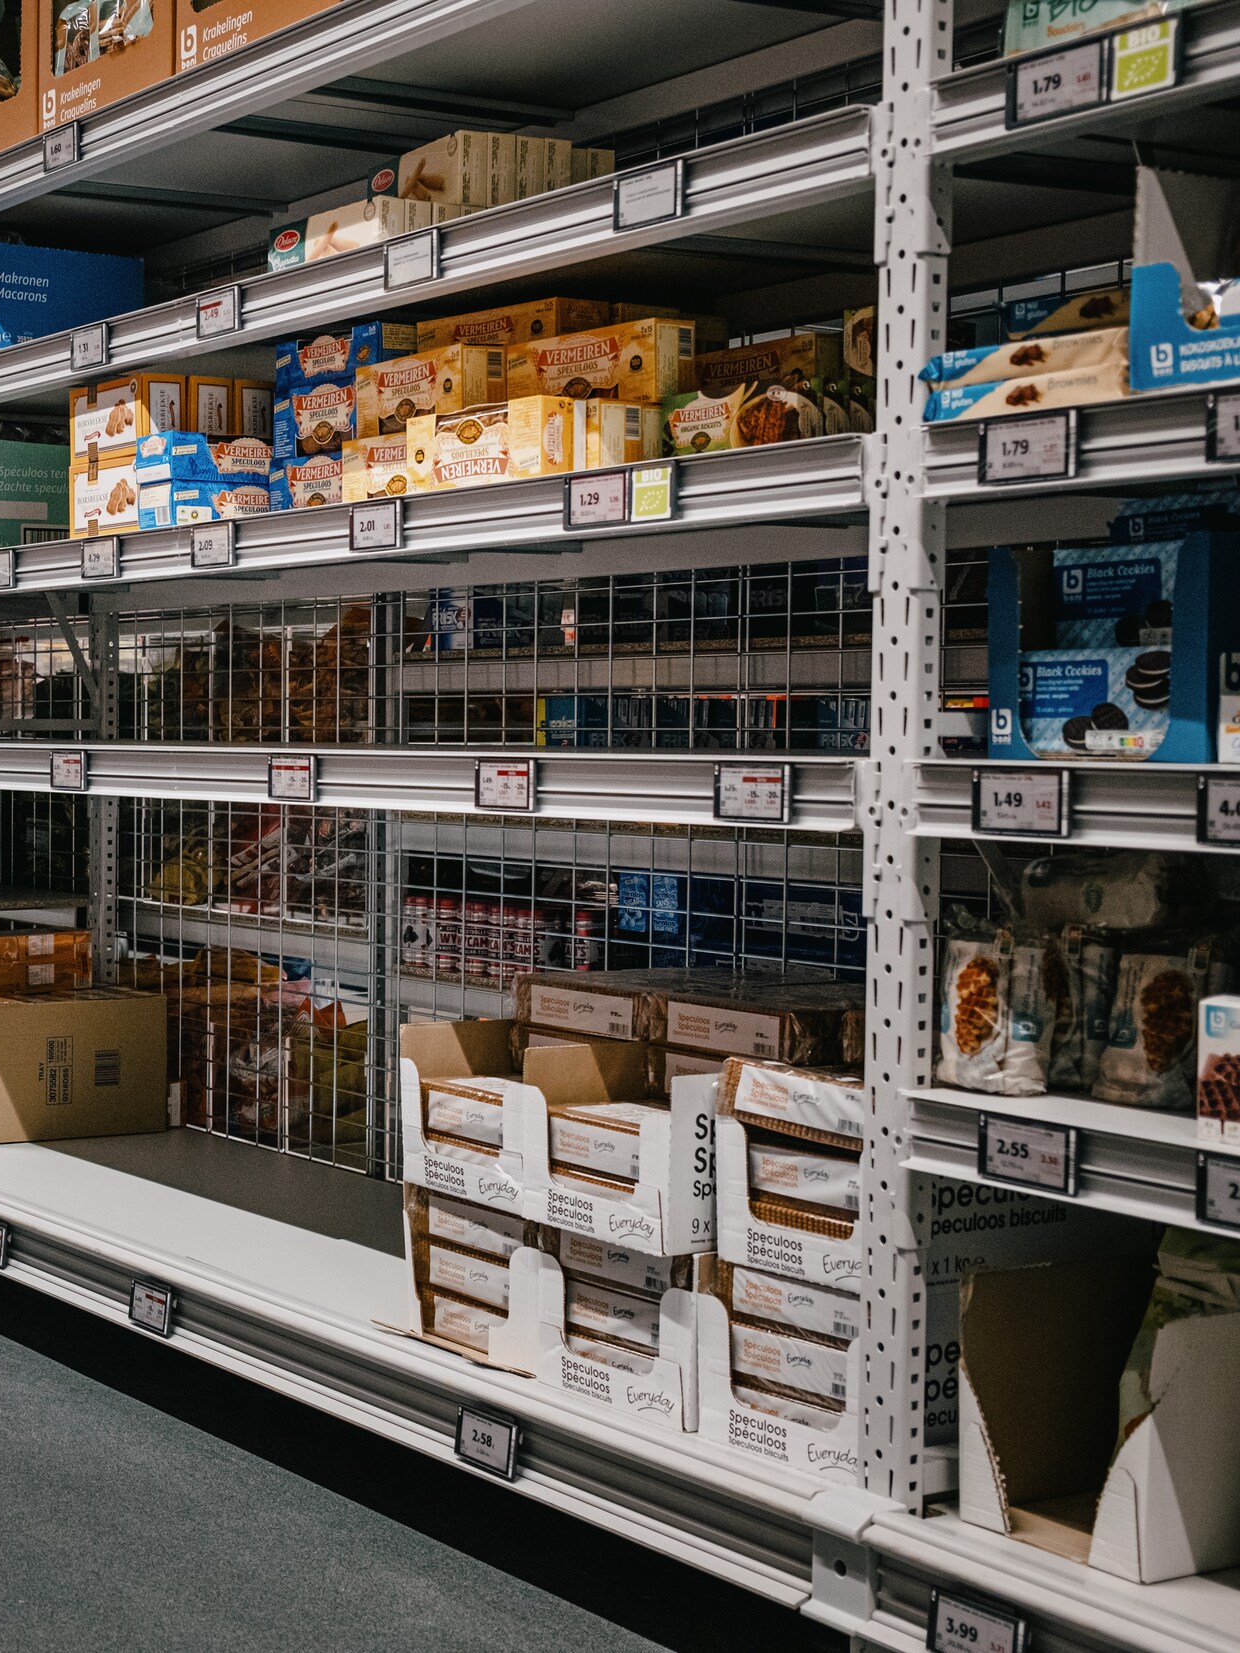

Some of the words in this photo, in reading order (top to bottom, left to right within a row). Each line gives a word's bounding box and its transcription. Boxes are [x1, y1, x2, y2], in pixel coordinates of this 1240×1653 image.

[202, 10, 253, 42] Krakelingen
[1128, 26, 1160, 48] BIO
[202, 32, 248, 61] Craquelins
[181, 58, 197, 70] boni
[60, 78, 102, 105] Krakelingen
[1032, 74, 1062, 95] 1,79
[60, 98, 98, 122] Craquelins
[43, 118, 56, 129] boni
[459, 318, 507, 337] VERMEIREN
[306, 343, 342, 358] VERMEIREN
[1052, 334, 1104, 350] Brownies
[1178, 336, 1240, 356] KOKOSKOEK
[546, 339, 610, 365] VERMEIREN
[312, 356, 336, 366] SPECULOOS
[556, 360, 598, 376] SPECULOOS
[710, 354, 773, 378] VERMEIREN
[1180, 354, 1221, 373] BISCUITS
[384, 366, 430, 387] VERMEIREN
[1047, 374, 1098, 391] Brownies
[392, 384, 421, 397] SPECULOOS
[302, 390, 348, 410] VERMEIREN
[310, 406, 339, 419] SPECULOOS
[680, 405, 726, 422] VERMEIREN
[77, 416, 108, 429] BORSBEEKSE
[224, 444, 274, 458] VERMEIREN
[374, 447, 407, 462] VERMEI
[1002, 439, 1029, 456] 1,79
[231, 458, 266, 466] SPECULOOS
[441, 458, 500, 480] VERMEIREN
[295, 462, 342, 481] VERMEIREN
[641, 466, 662, 482] BIO
[303, 479, 332, 490] SPECULOOS
[77, 492, 108, 505] BORSBEEKSE
[226, 492, 270, 505] VERMEIRE
[580, 492, 600, 506] 1,29
[360, 520, 375, 532] 2,01
[1087, 567, 1115, 578] Black
[1118, 564, 1155, 576] Cookies
[1036, 666, 1062, 677] Black
[1064, 665, 1102, 676] Cookies
[992, 792, 1024, 808] 1,49
[622, 890, 644, 898] mentos
[573, 1002, 595, 1012] Everyday
[678, 1012, 710, 1026] Speculoos
[714, 1020, 738, 1031] Everyday
[466, 1110, 484, 1121] Everyday
[594, 1140, 616, 1151] Everyday
[996, 1140, 1030, 1159] 2,55
[424, 1155, 465, 1176] Speculoos
[762, 1156, 798, 1172] Speculoos
[424, 1166, 466, 1188] Spéculoos
[804, 1168, 830, 1180] Everyday
[424, 1178, 448, 1194] Speculoos
[449, 1186, 468, 1196] biscuits
[478, 1177, 520, 1200] Everyday
[547, 1188, 594, 1212] Speculoos
[546, 1200, 593, 1224] Spéculoos
[931, 1212, 1006, 1237] peculoos
[1010, 1204, 1068, 1226] biscuits
[546, 1213, 574, 1229] Speculoos
[574, 1222, 594, 1234] biscuits
[608, 1214, 655, 1238] Everyday
[692, 1218, 699, 1234] 9
[703, 1222, 710, 1232] x
[570, 1237, 603, 1253] Speculoos
[747, 1228, 802, 1252] Speculoos
[607, 1250, 630, 1262] Everyday
[746, 1241, 802, 1265] Spéculoos
[746, 1255, 780, 1270] Speculoos
[781, 1264, 805, 1276] biscuits
[823, 1254, 862, 1276] Every
[469, 1270, 490, 1282] Everyday
[746, 1280, 782, 1296] Speculoos
[788, 1293, 814, 1305] Everyday
[612, 1306, 636, 1318] Everyday
[744, 1339, 781, 1356] Speculoos
[786, 1352, 814, 1366] Everyday
[561, 1356, 610, 1382] Speculoos
[561, 1370, 610, 1394] Spéculoos
[562, 1380, 590, 1398] Speculoos
[592, 1390, 612, 1404] biscuits
[626, 1386, 674, 1414] Everyday
[729, 1409, 787, 1438] Speculoos
[472, 1428, 492, 1448] 2,58
[728, 1423, 786, 1451] Spéculoos
[728, 1436, 762, 1454] Speculoos
[764, 1448, 789, 1462] biscuits
[946, 1616, 978, 1642] 3,99
